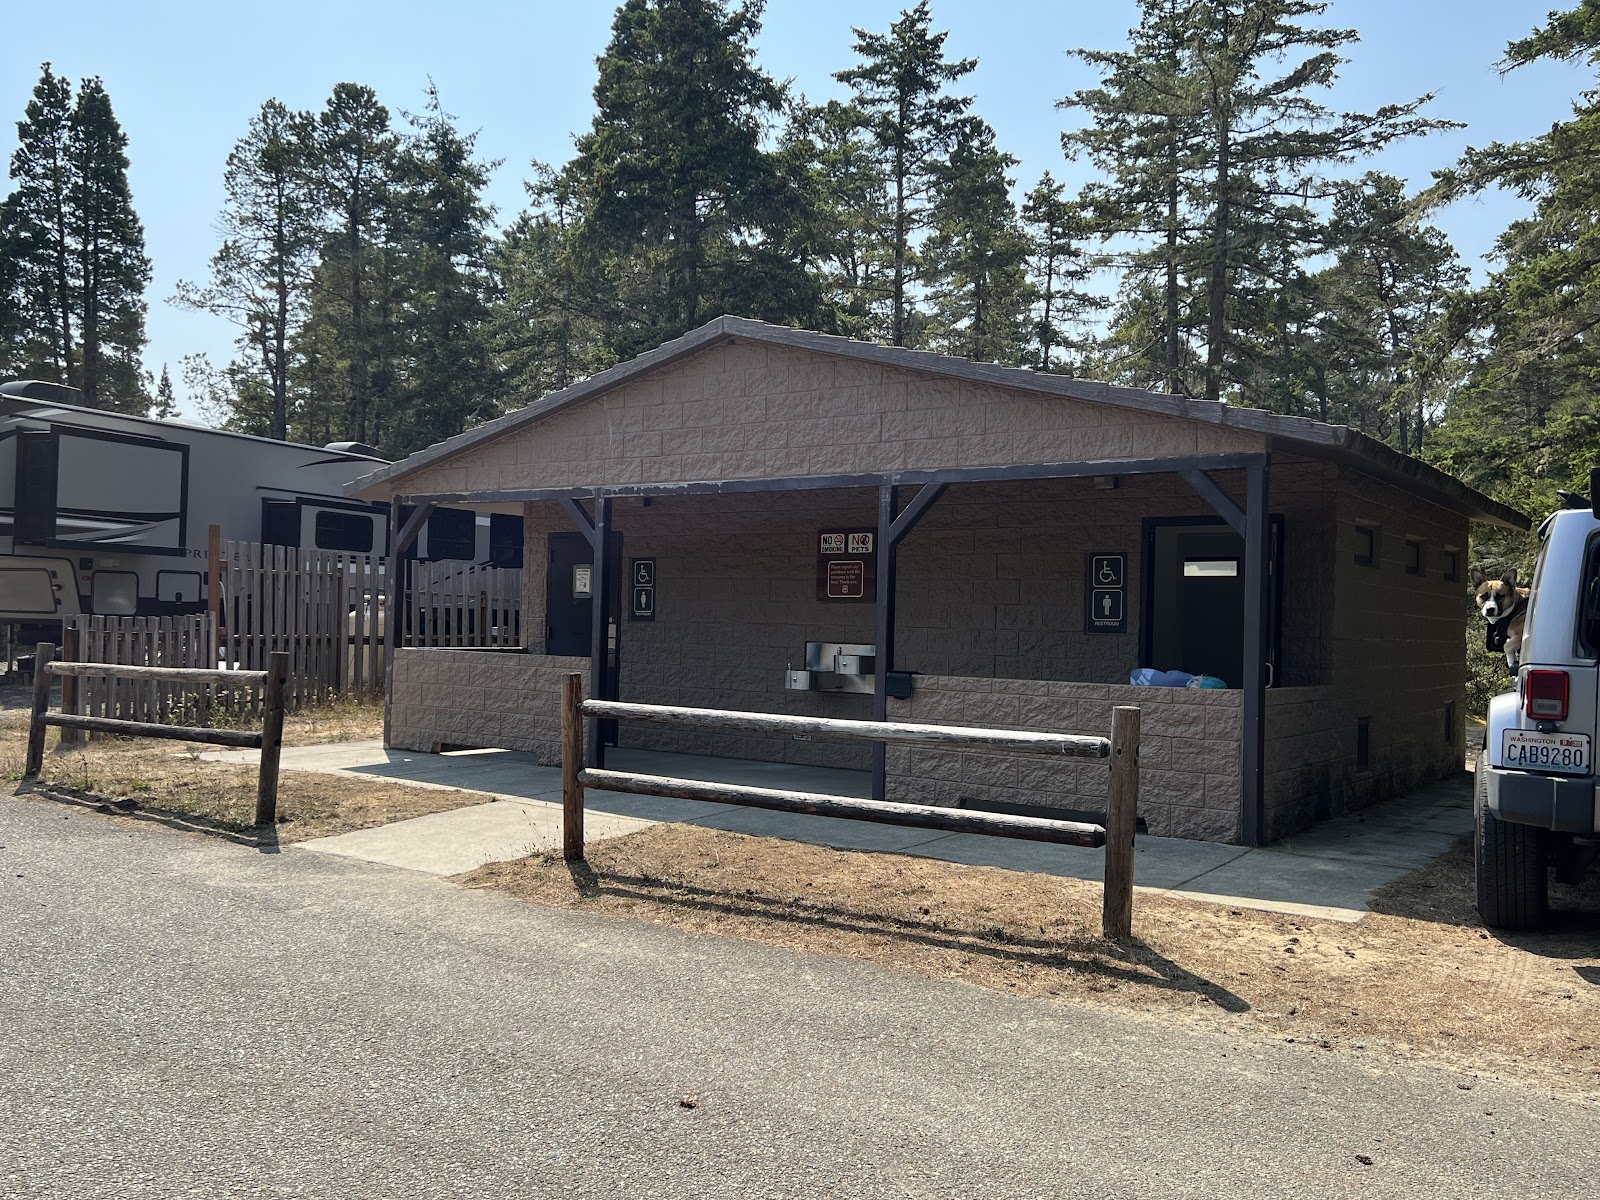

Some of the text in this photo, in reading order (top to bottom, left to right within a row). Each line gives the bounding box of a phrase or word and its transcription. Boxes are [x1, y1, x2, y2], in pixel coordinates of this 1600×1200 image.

[822, 536, 832, 544] NO
[1510, 736, 1556, 744] WASHINGTON
[1508, 744, 1582, 767] CAB9280
